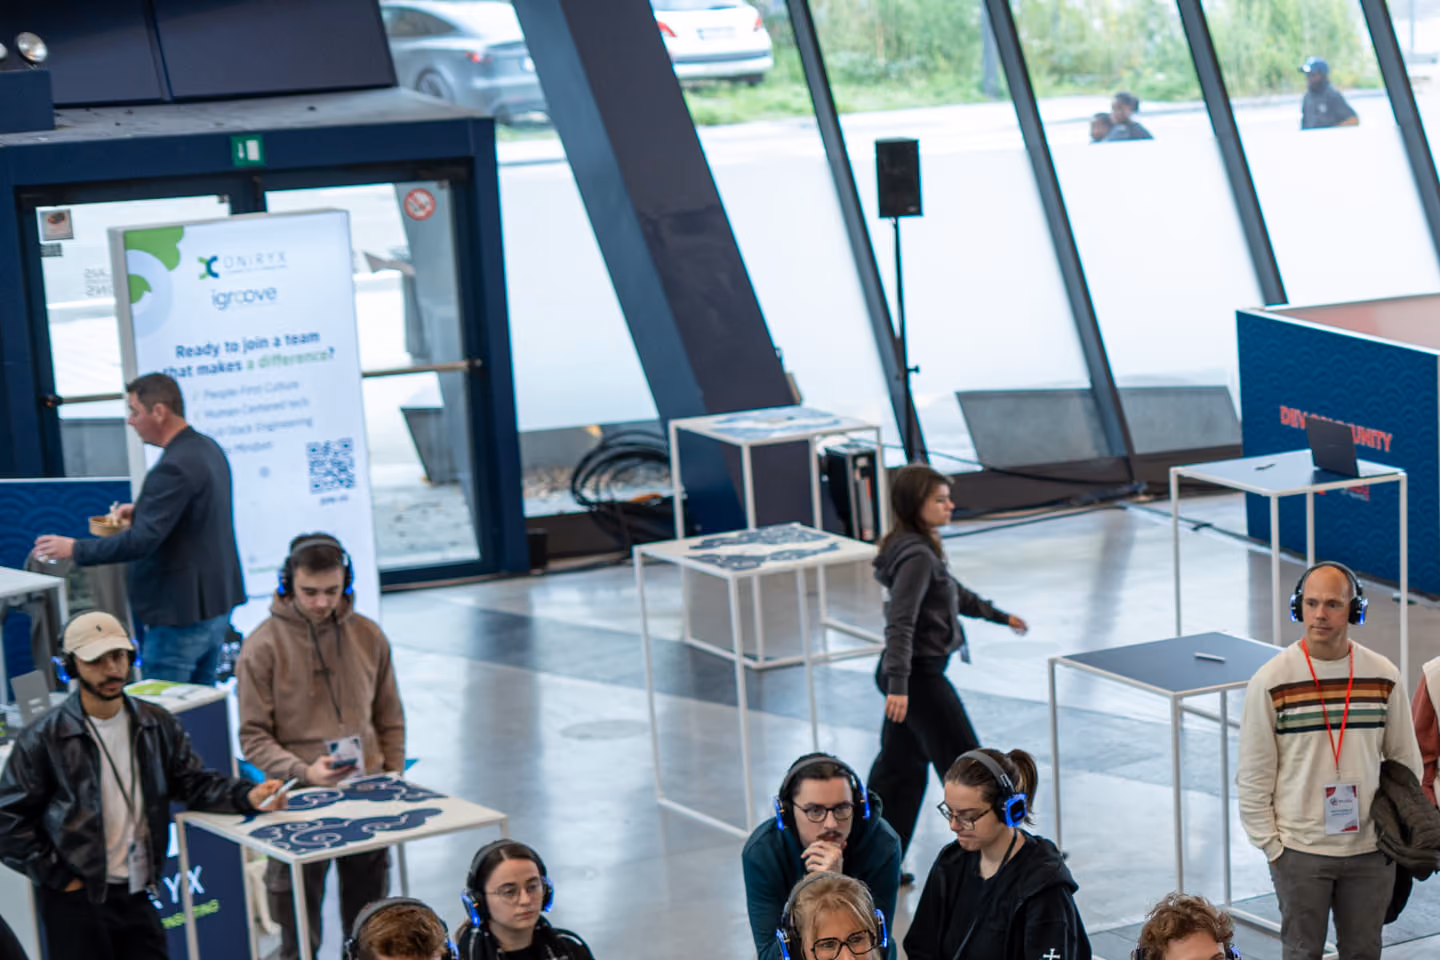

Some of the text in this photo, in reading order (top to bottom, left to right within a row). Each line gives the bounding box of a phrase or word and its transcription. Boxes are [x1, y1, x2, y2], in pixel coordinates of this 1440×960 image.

[175, 331, 320, 359] Ready to join a team
[196, 359, 242, 376] makes
